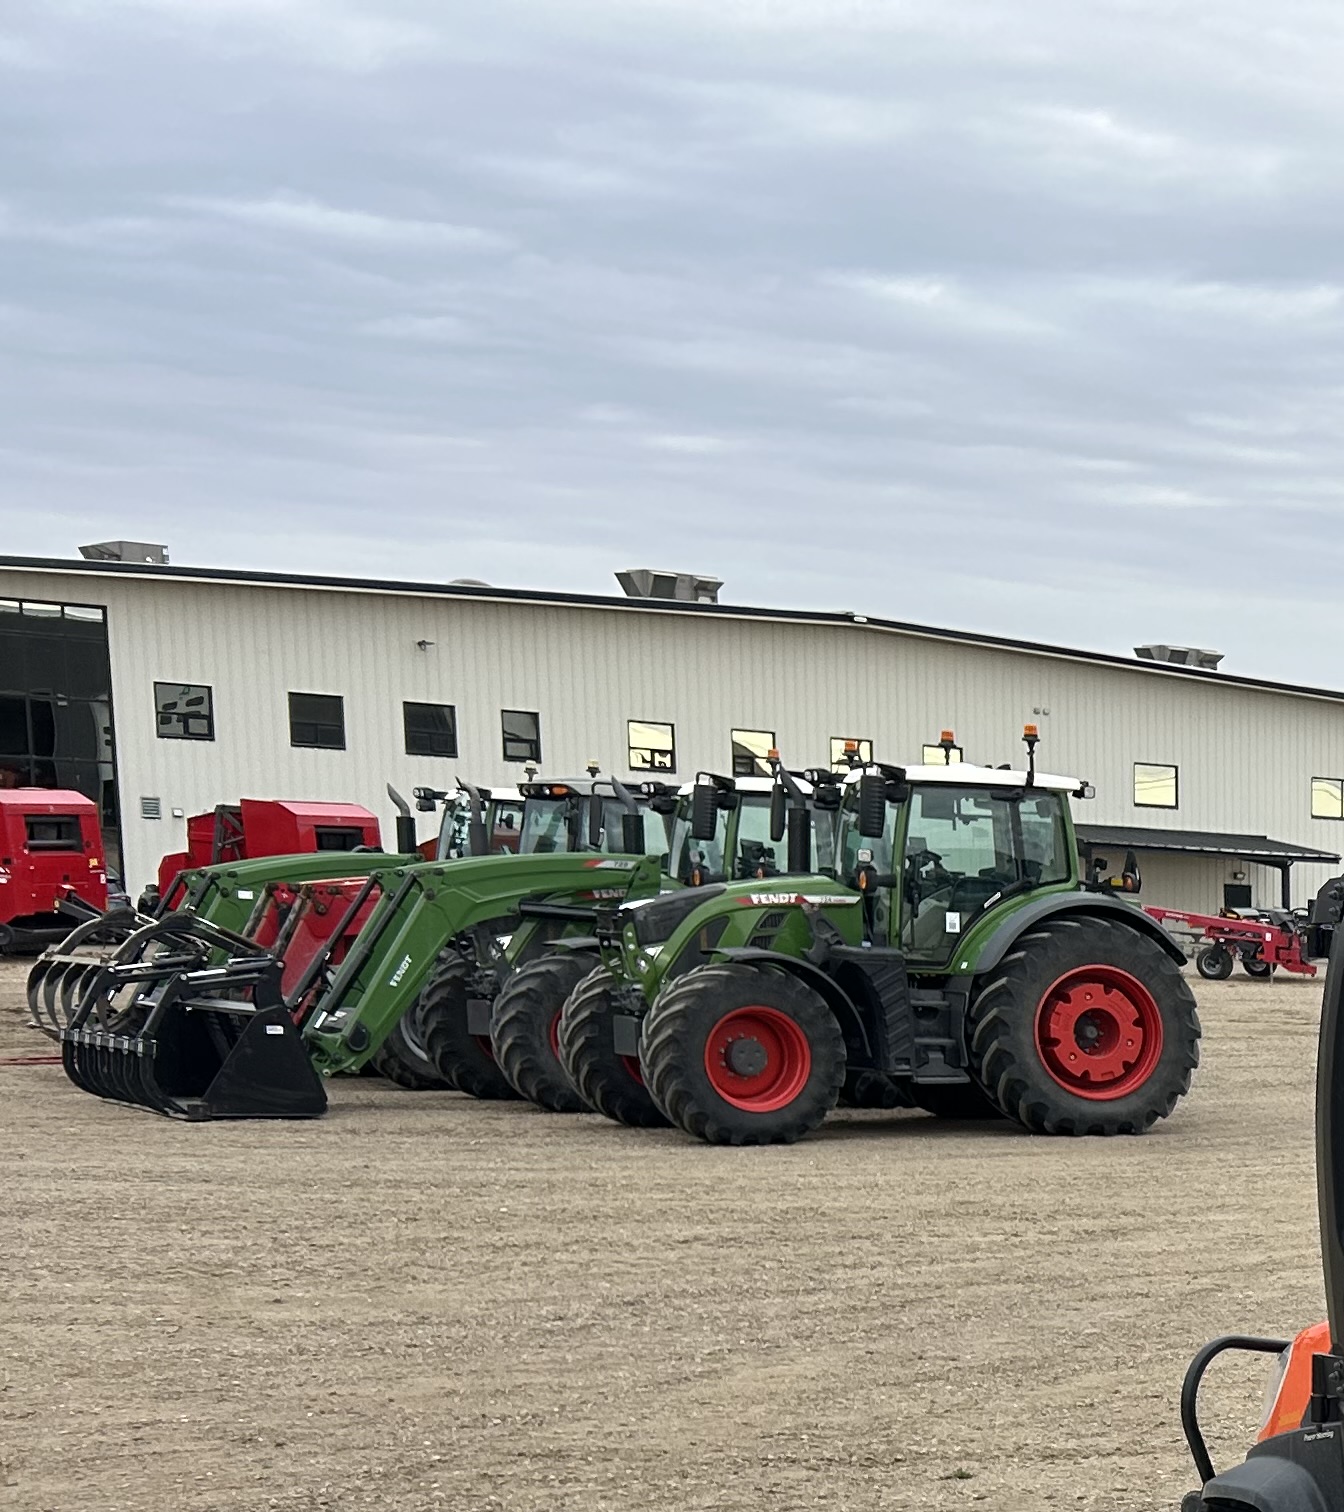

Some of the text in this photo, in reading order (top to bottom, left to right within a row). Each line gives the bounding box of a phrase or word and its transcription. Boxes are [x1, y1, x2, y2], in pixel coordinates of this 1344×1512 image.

[592, 888, 628, 899] FEND
[750, 892, 799, 905] FENDT
[389, 954, 412, 987] FENDT
